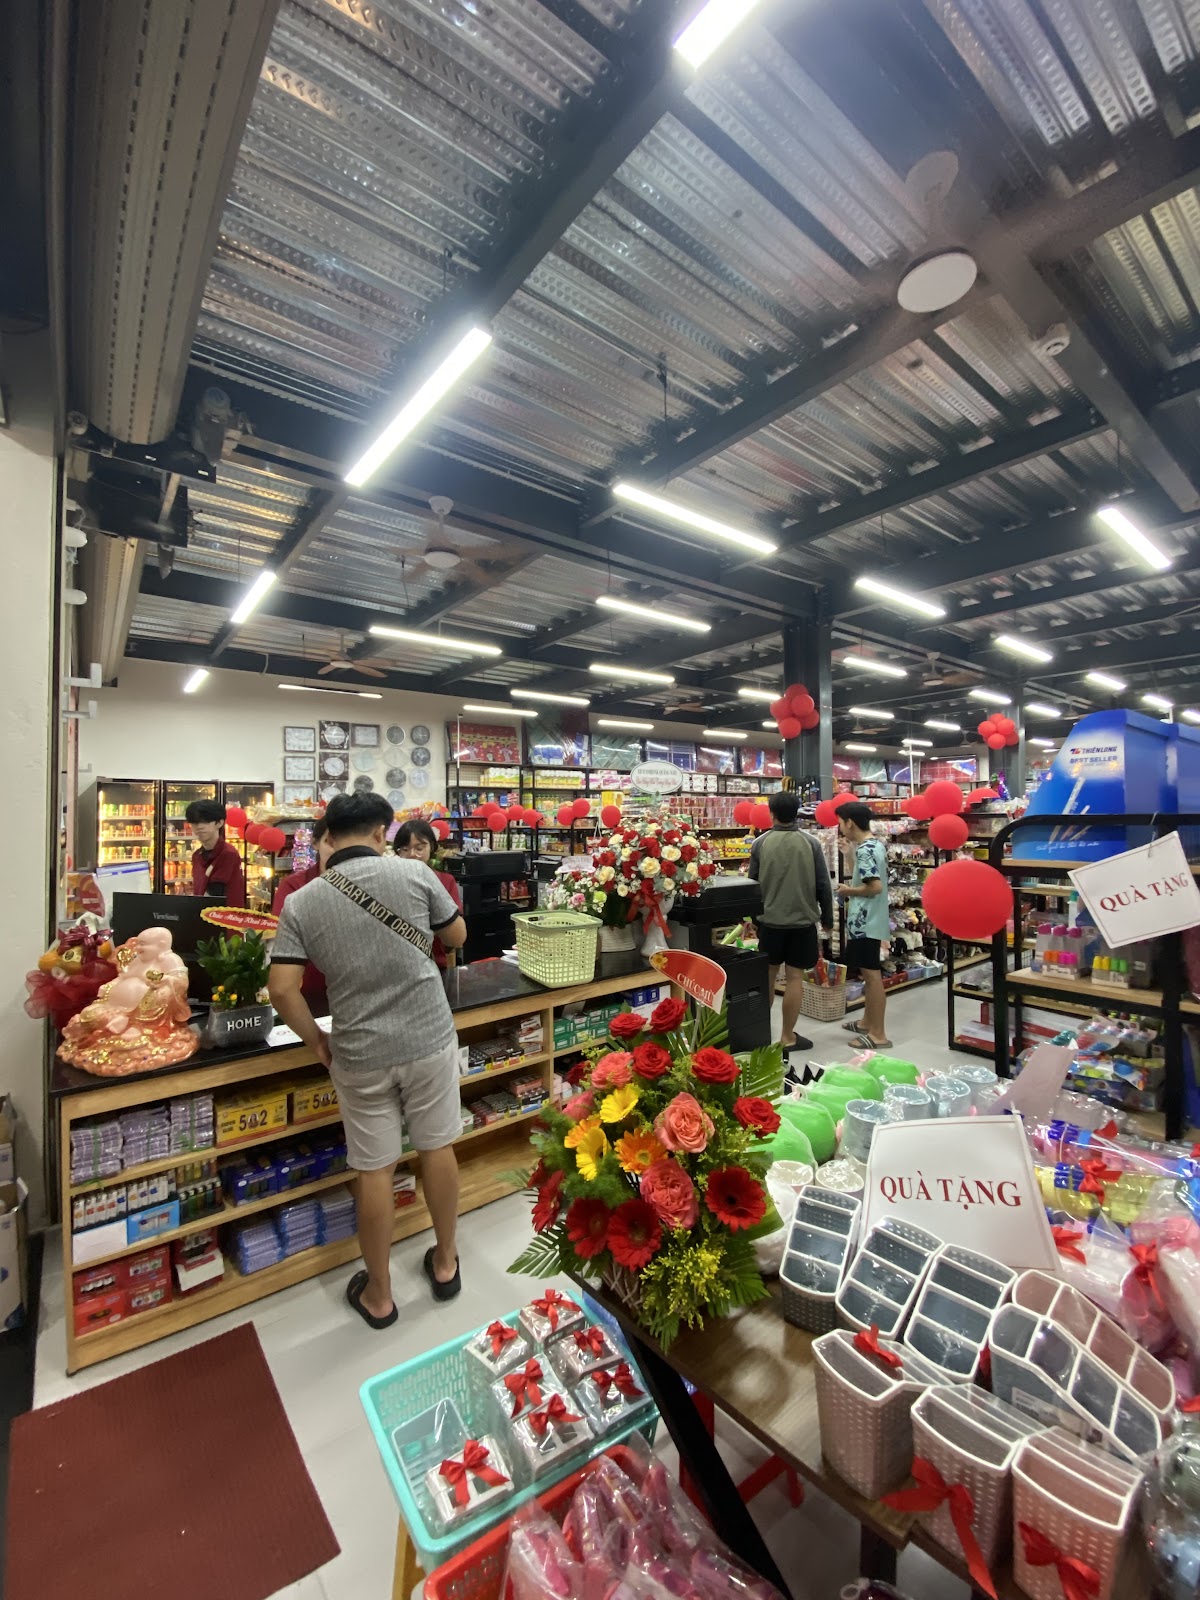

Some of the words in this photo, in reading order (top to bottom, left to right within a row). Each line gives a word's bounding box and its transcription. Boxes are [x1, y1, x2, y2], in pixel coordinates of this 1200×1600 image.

[1099, 884, 1148, 912] QUÀ
[1147, 872, 1189, 897] TẶNG
[323, 868, 371, 906] RDINARY
[366, 899, 394, 922] NOT
[390, 917, 433, 958] ORDINARY
[677, 972, 701, 994] CHÚC
[226, 1015, 262, 1032] HOME
[880, 1170, 933, 1204] QUÀ
[936, 1175, 1023, 1211] TẶNG
